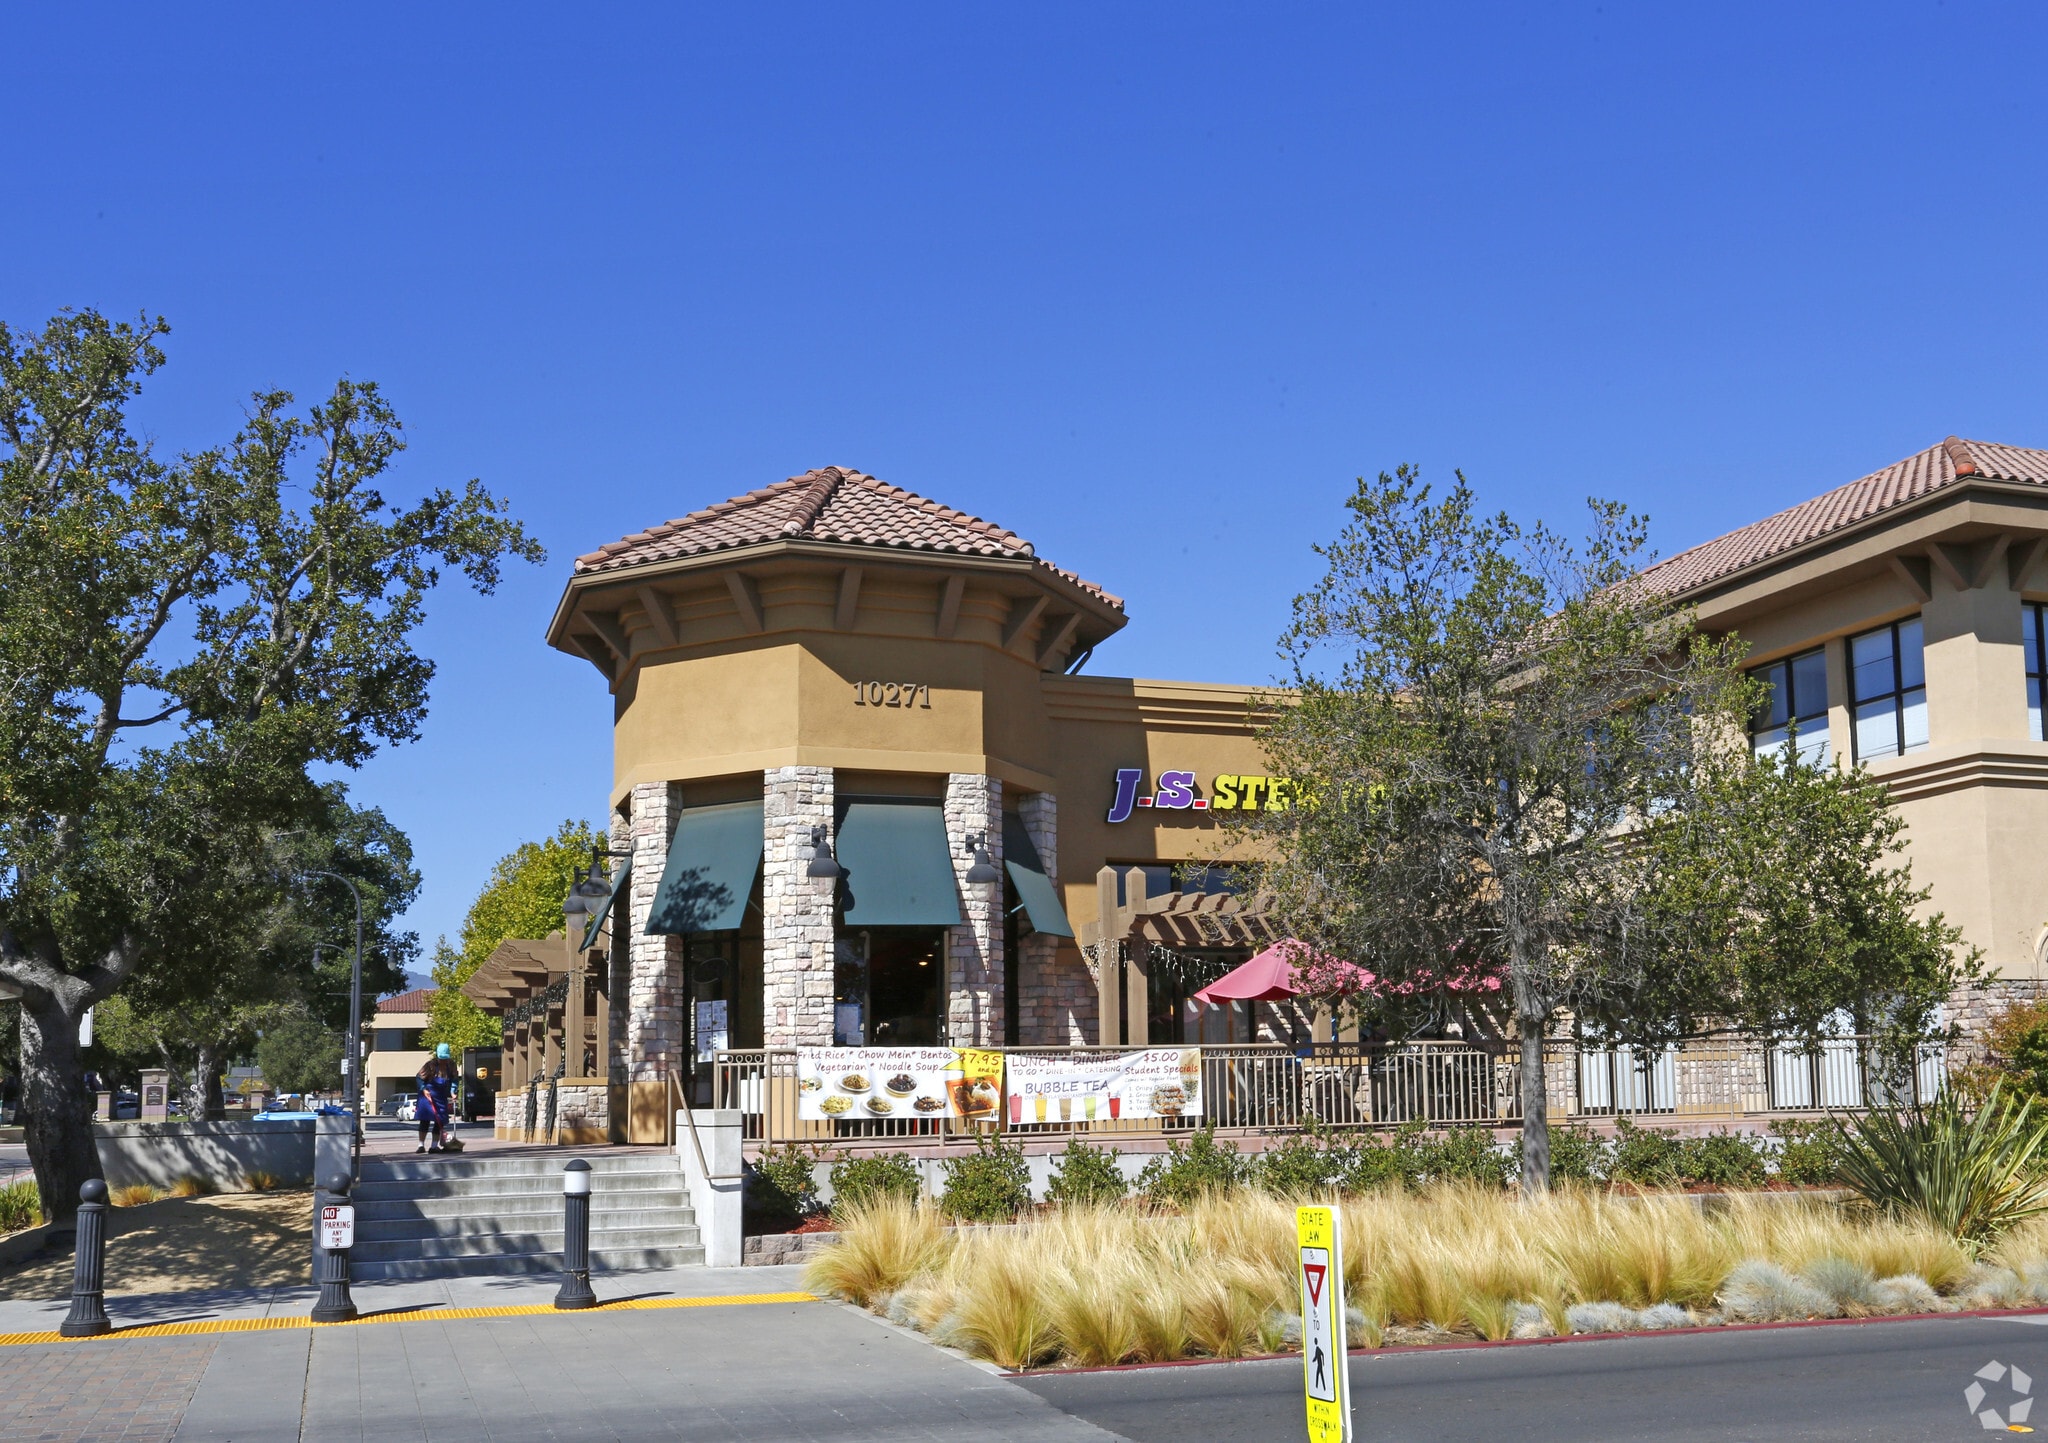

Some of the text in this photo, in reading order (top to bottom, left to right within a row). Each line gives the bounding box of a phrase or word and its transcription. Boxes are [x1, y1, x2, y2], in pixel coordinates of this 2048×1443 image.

[853, 680, 931, 709] 10271
[1107, 768, 1209, 823] J.S.
[797, 1049, 821, 1060] Fried
[825, 1050, 845, 1060] Rice
[857, 1050, 885, 1060] Chow
[920, 1049, 952, 1060] Bentos
[960, 1050, 1001, 1066] $7.95
[1012, 1053, 1121, 1068] LUNCH DINNER
[1144, 1051, 1179, 1063] $5.00
[814, 1062, 939, 1075] Vegetarian Noodle Soup
[1026, 1068, 1037, 1076] GO
[1085, 1065, 1121, 1074] CATERING
[1125, 1064, 1198, 1076] Student Specials
[1025, 1079, 1110, 1094] BUBBLE TEA
[324, 1208, 335, 1218] NO
[1301, 1212, 1323, 1226] STATE
[324, 1220, 351, 1229] PARKING
[1304, 1230, 1320, 1243] LAW
[1313, 1319, 1321, 1331] TO
